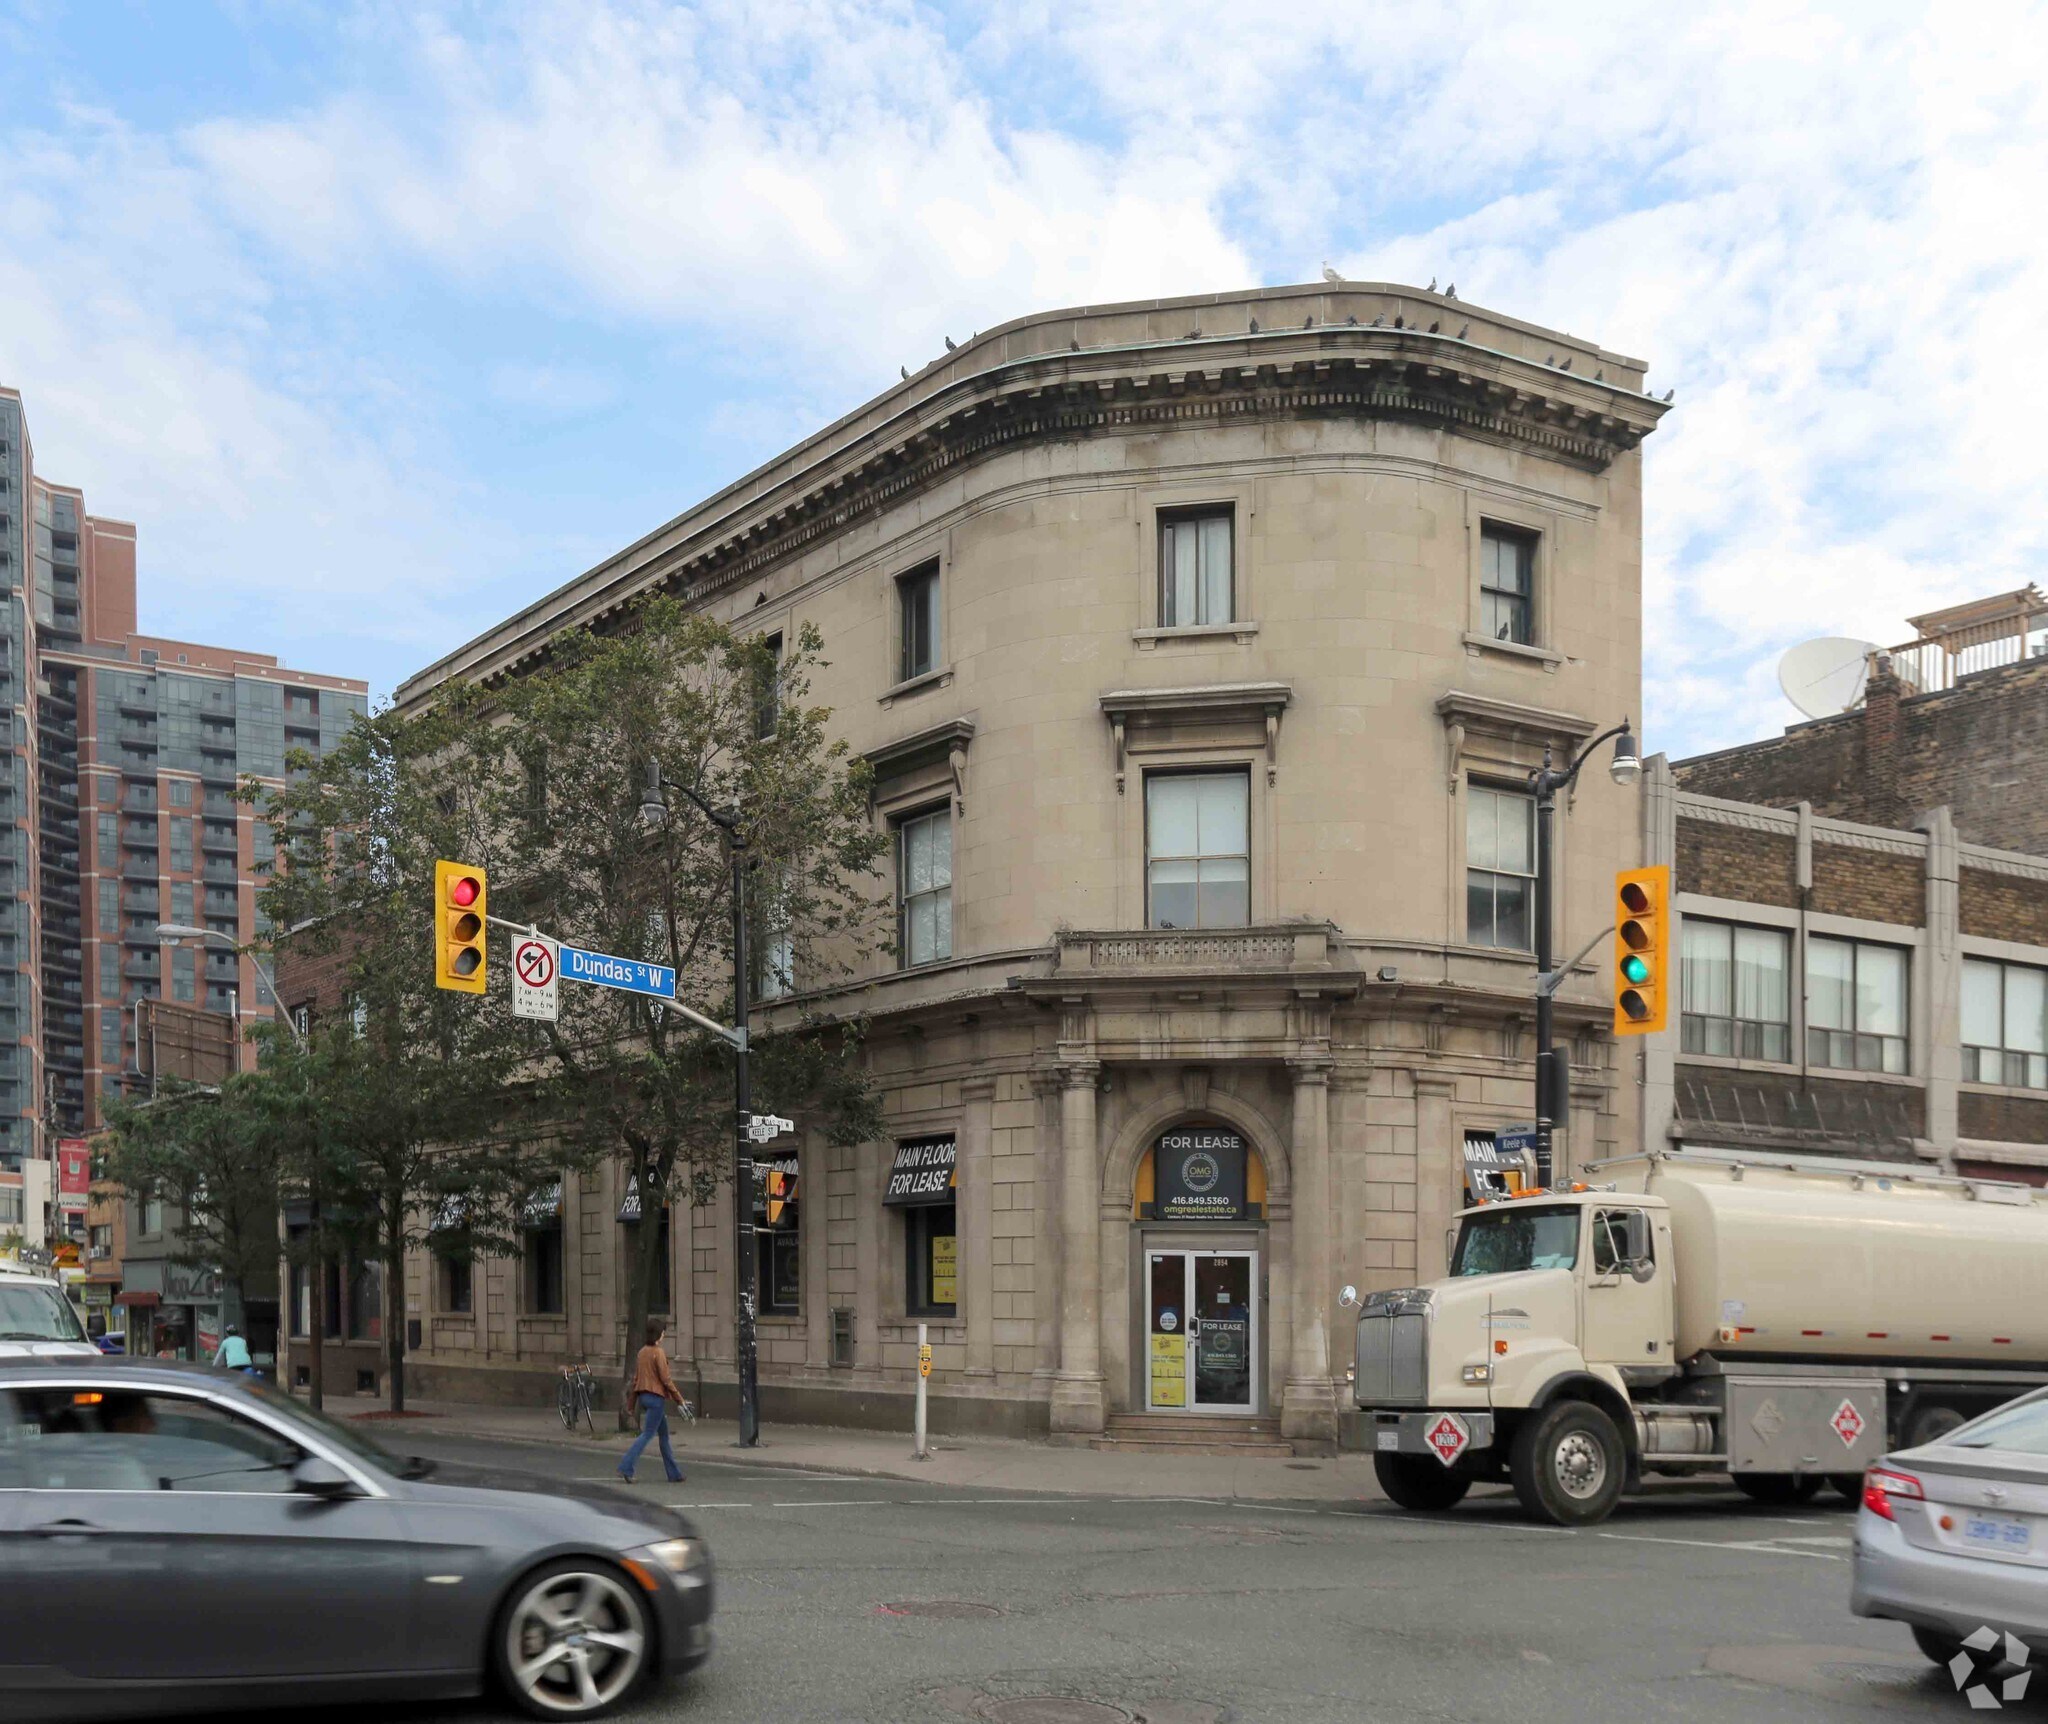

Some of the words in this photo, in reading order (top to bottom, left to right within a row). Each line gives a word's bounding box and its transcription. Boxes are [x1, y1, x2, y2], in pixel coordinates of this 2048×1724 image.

[572, 952, 633, 983] Dundas
[637, 966, 646, 978] St
[649, 967, 662, 988] W
[540, 1000, 545, 1009] 6
[1161, 1136, 1192, 1149] FOR
[1195, 1136, 1240, 1149] LEASE
[1502, 1138, 1520, 1149] Keele
[893, 1146, 923, 1169] MAIN
[920, 1142, 957, 1166] FLOOR
[1464, 1140, 1499, 1164] MAIN
[1189, 1166, 1212, 1175] OMG
[888, 1173, 913, 1195] FOR
[911, 1169, 949, 1193] LEASE
[1473, 1168, 1500, 1191] FO
[1171, 1196, 1230, 1205] 416.849.5360
[1163, 1205, 1237, 1215] omgrealestate.ca
[1202, 1322, 1218, 1330] FOR
[1219, 1323, 1243, 1331] LEASE
[1436, 1434, 1457, 1446] 1203
